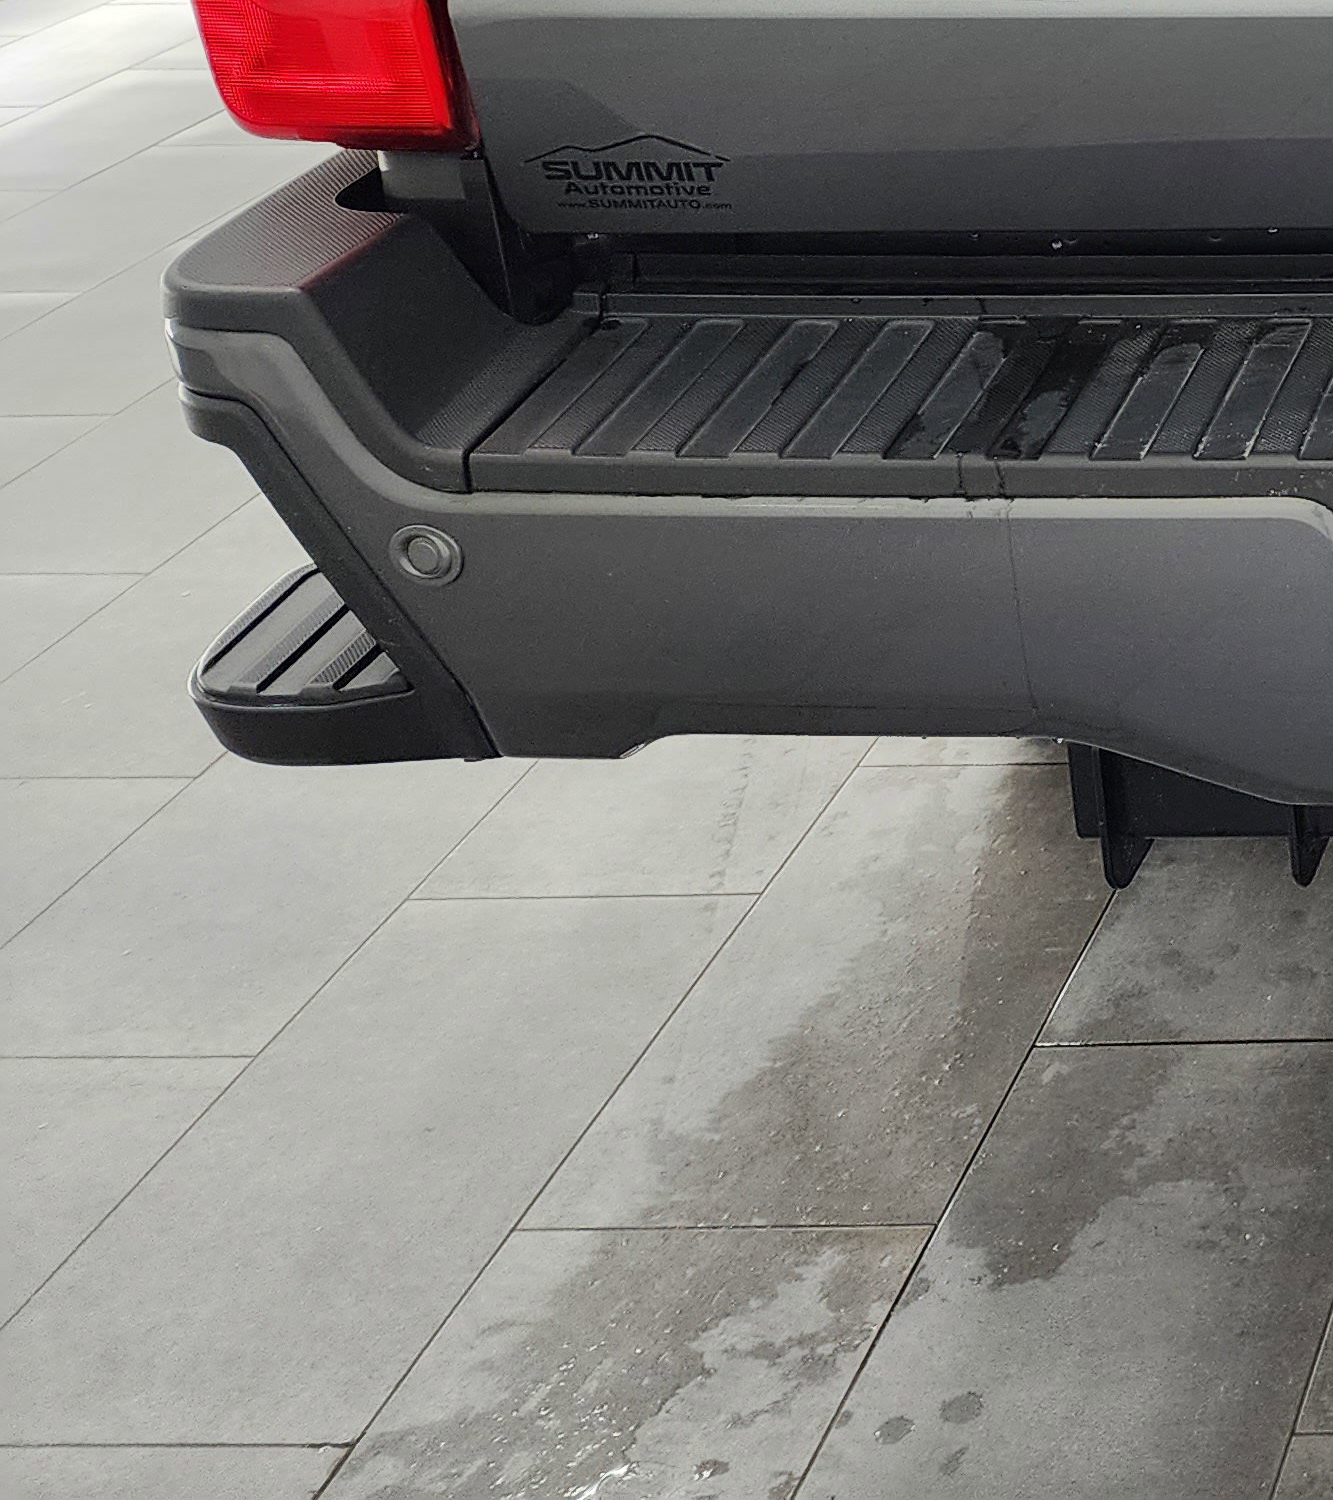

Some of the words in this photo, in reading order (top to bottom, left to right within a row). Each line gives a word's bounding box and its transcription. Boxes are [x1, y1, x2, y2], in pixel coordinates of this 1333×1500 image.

[541, 160, 724, 182] SUMMIT
[564, 181, 712, 196] Automotive
[557, 199, 733, 211] www.SUMMITAUTO.com
